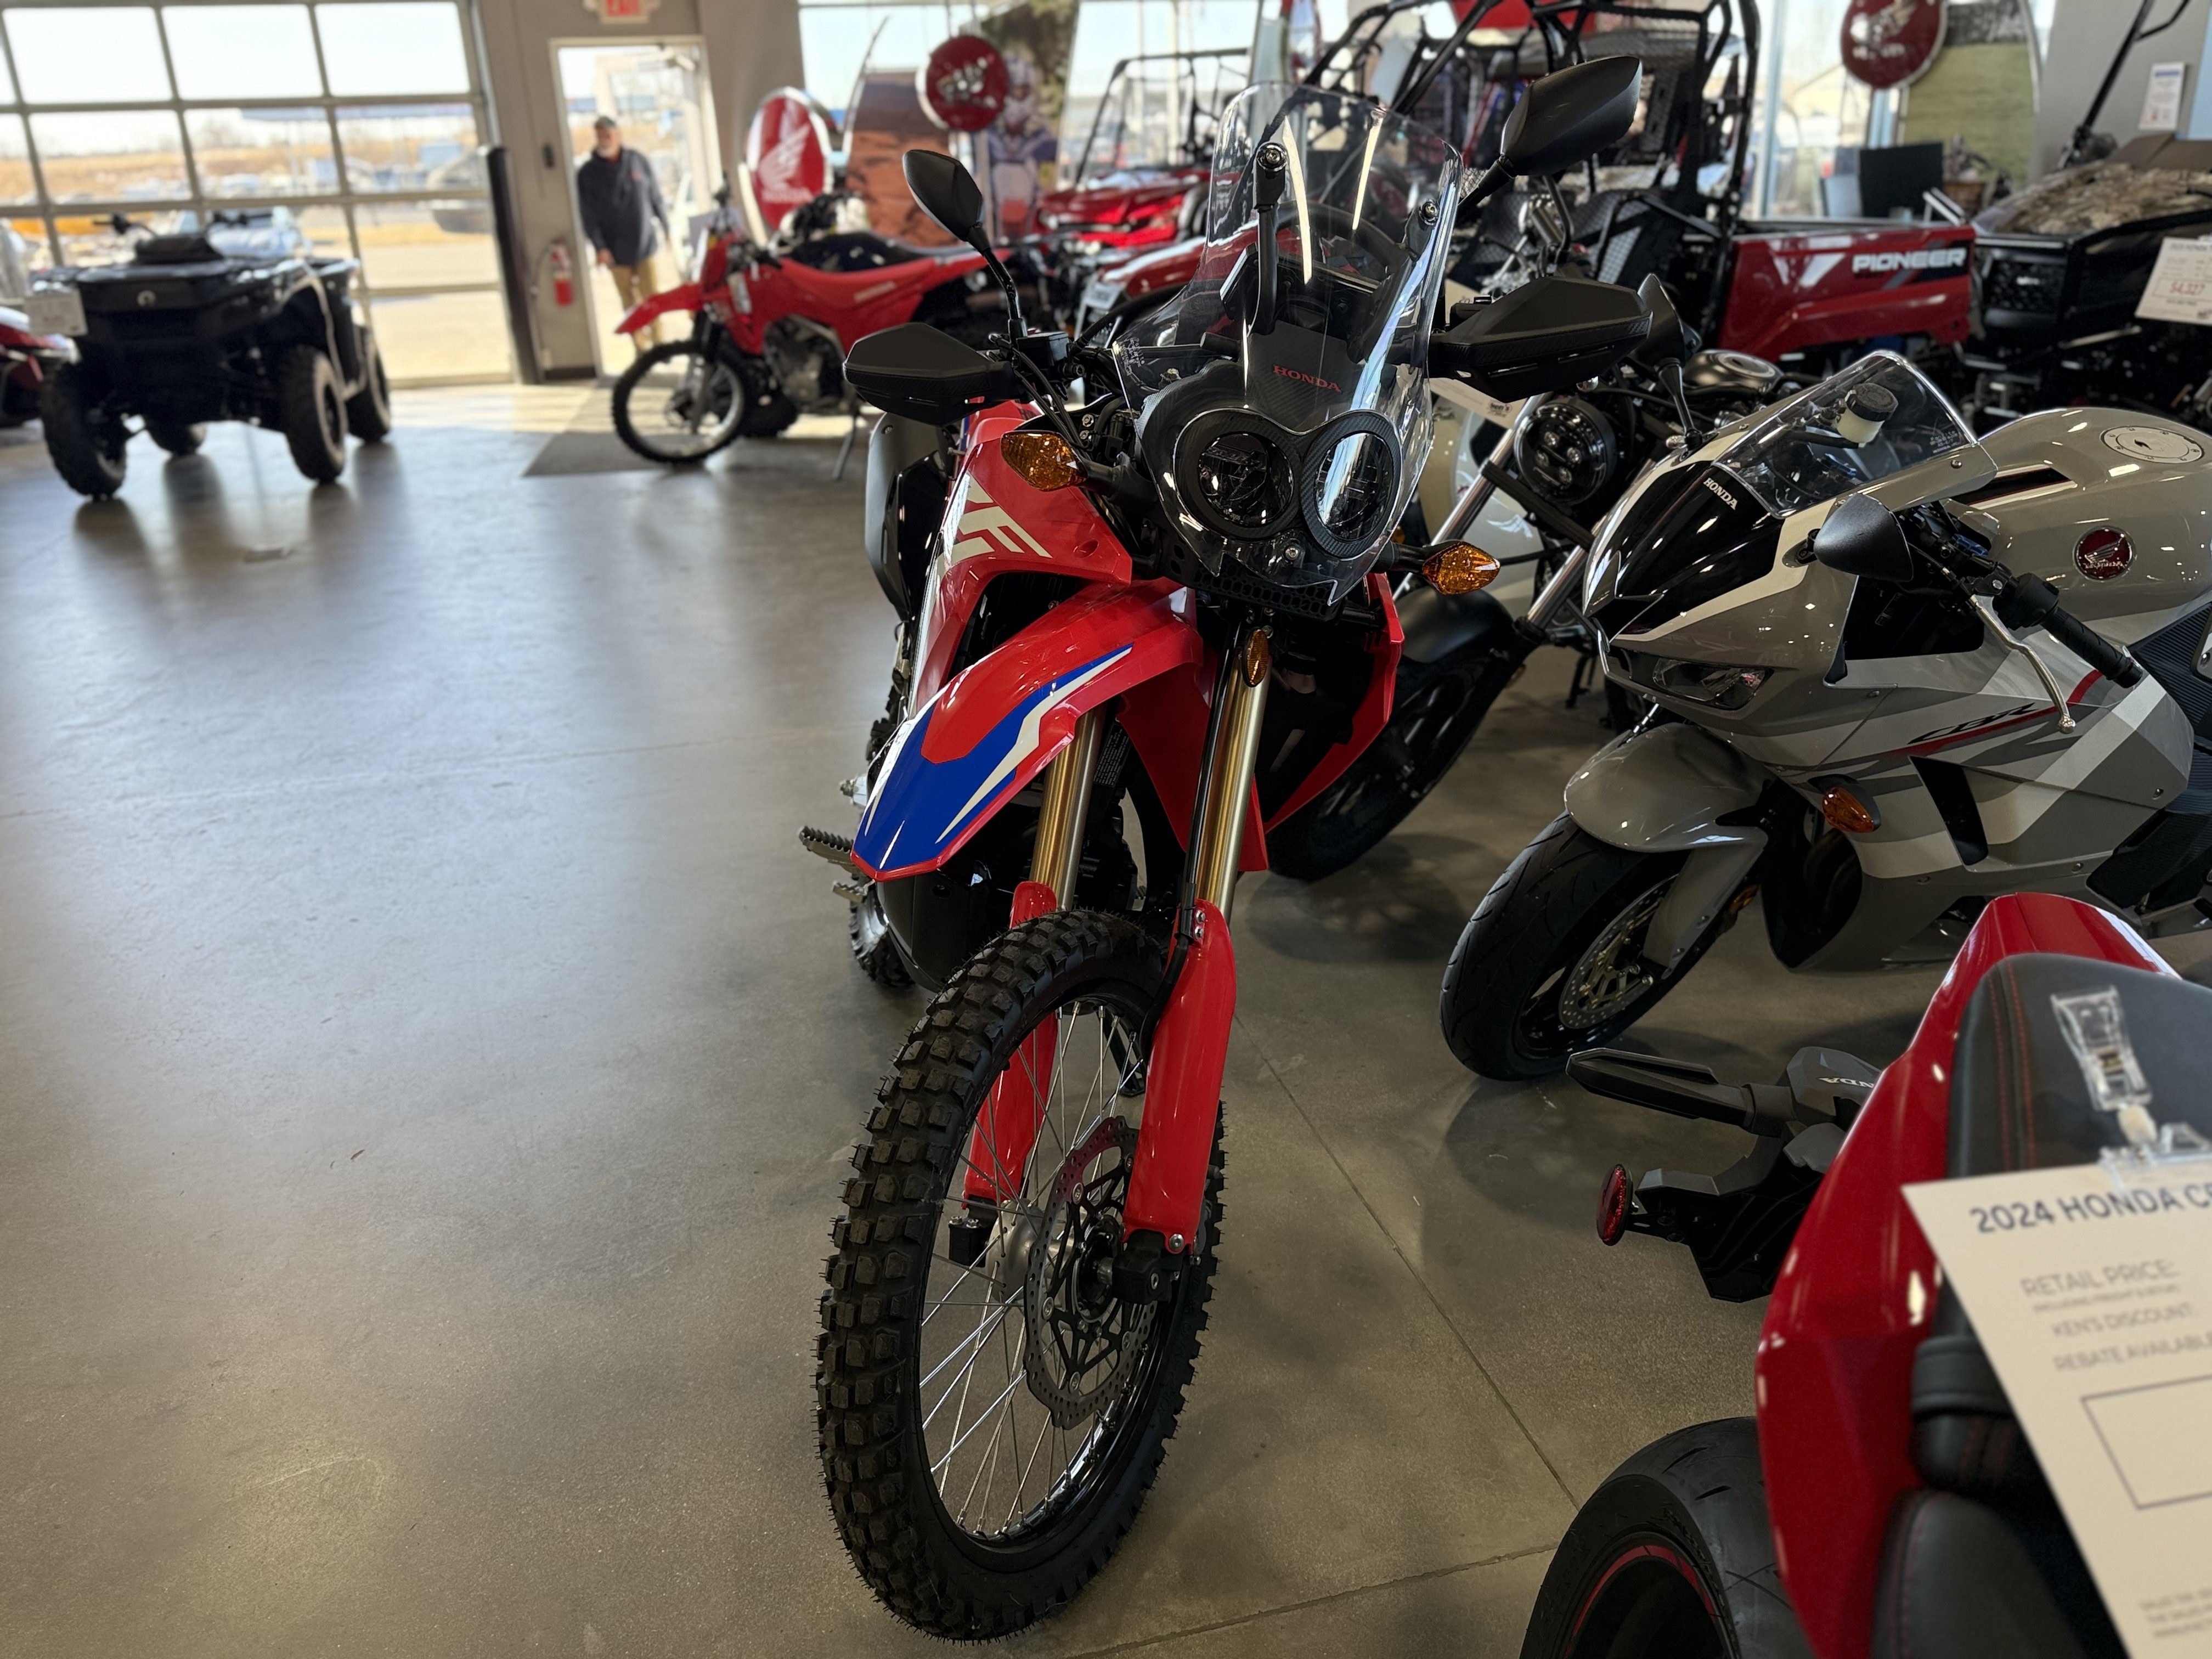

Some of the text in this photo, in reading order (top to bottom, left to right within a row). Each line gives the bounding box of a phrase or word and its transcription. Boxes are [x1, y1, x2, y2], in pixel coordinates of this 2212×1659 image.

[1852, 247, 1967, 273] PIONEER
[1273, 364, 1343, 394] HONDA
[1703, 477, 1737, 510] HONDA
[1818, 1077, 1875, 1088] NDA
[1970, 1200, 2055, 1234] 2024
[2056, 1186, 2185, 1223] HONDA
[2020, 1269, 2104, 1297] RETAIL
[2053, 1346, 2126, 1371] REBATE
